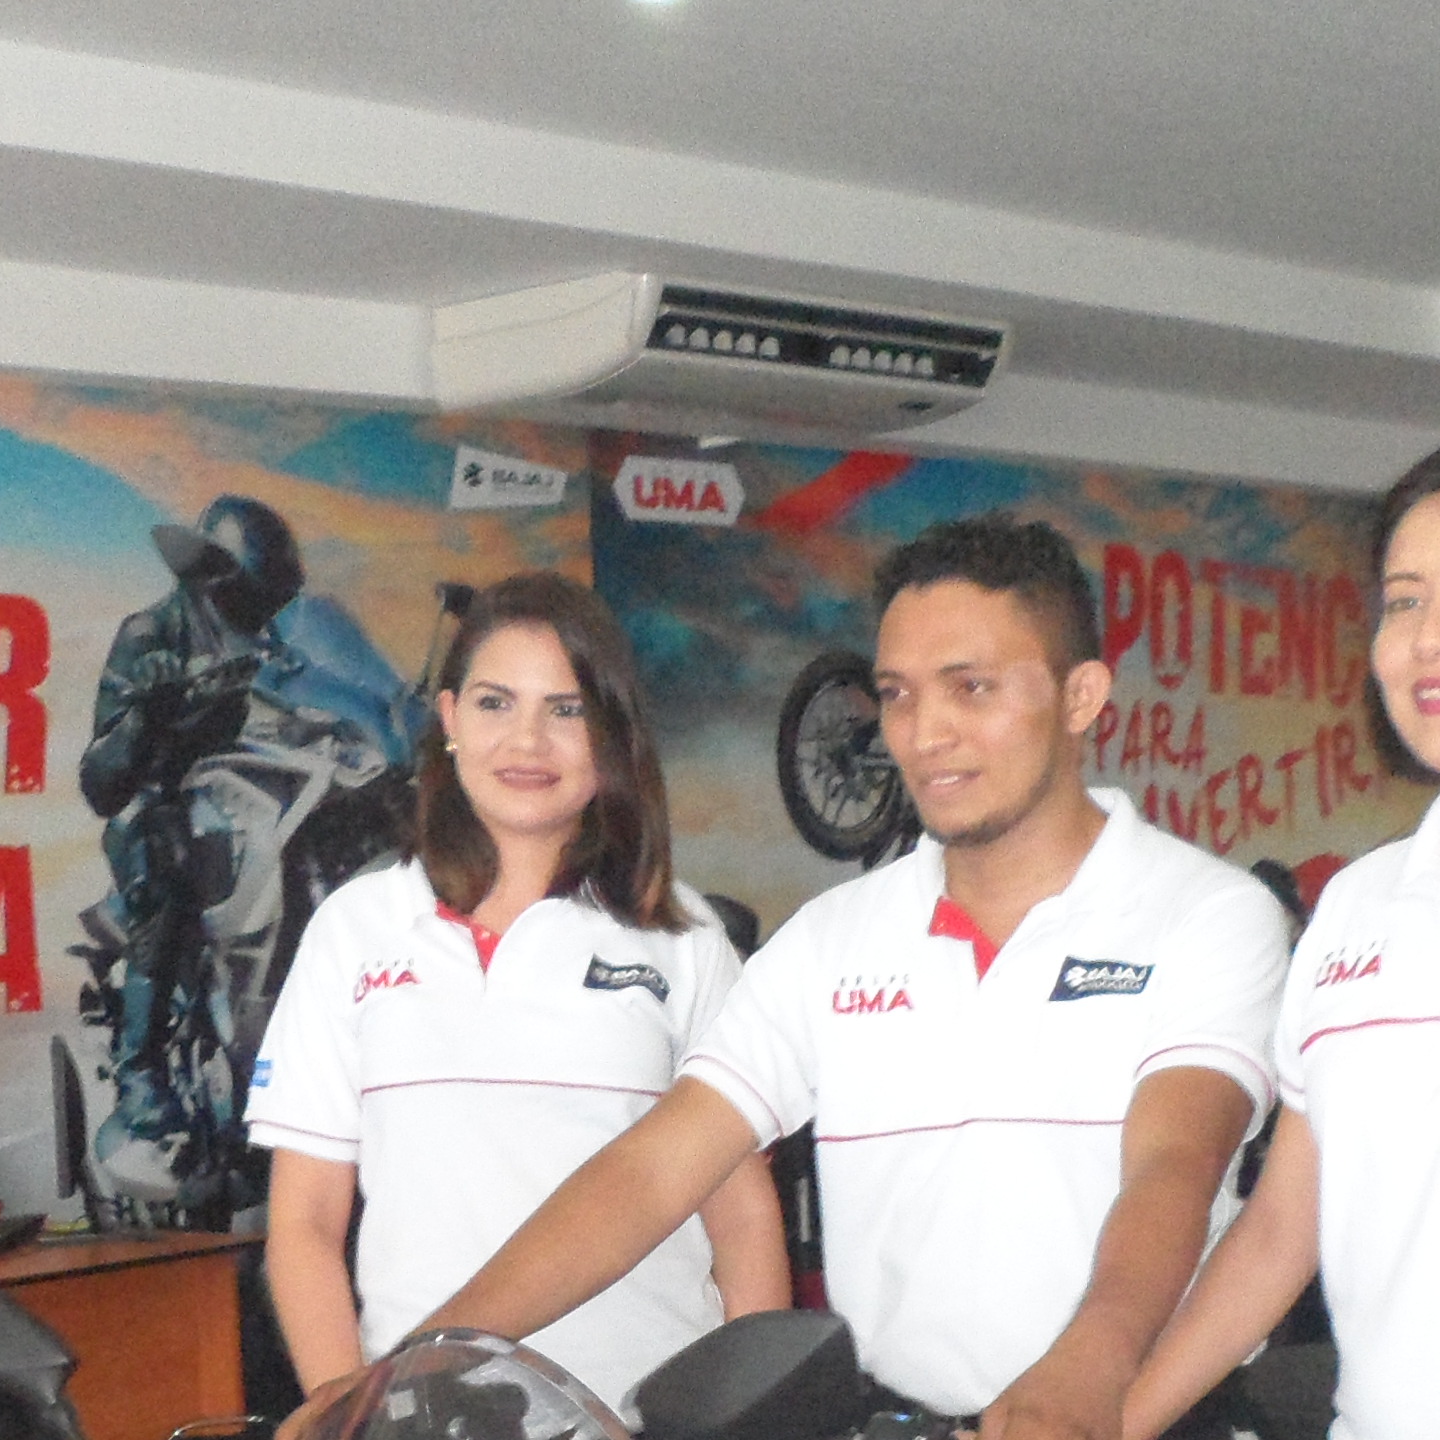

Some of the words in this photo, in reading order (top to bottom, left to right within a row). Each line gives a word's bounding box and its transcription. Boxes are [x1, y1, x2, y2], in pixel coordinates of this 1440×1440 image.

[632, 474, 727, 513] UMA
[1102, 543, 1367, 707] POTENC
[1095, 698, 1208, 774] PARA
[832, 987, 916, 1015] UMA
